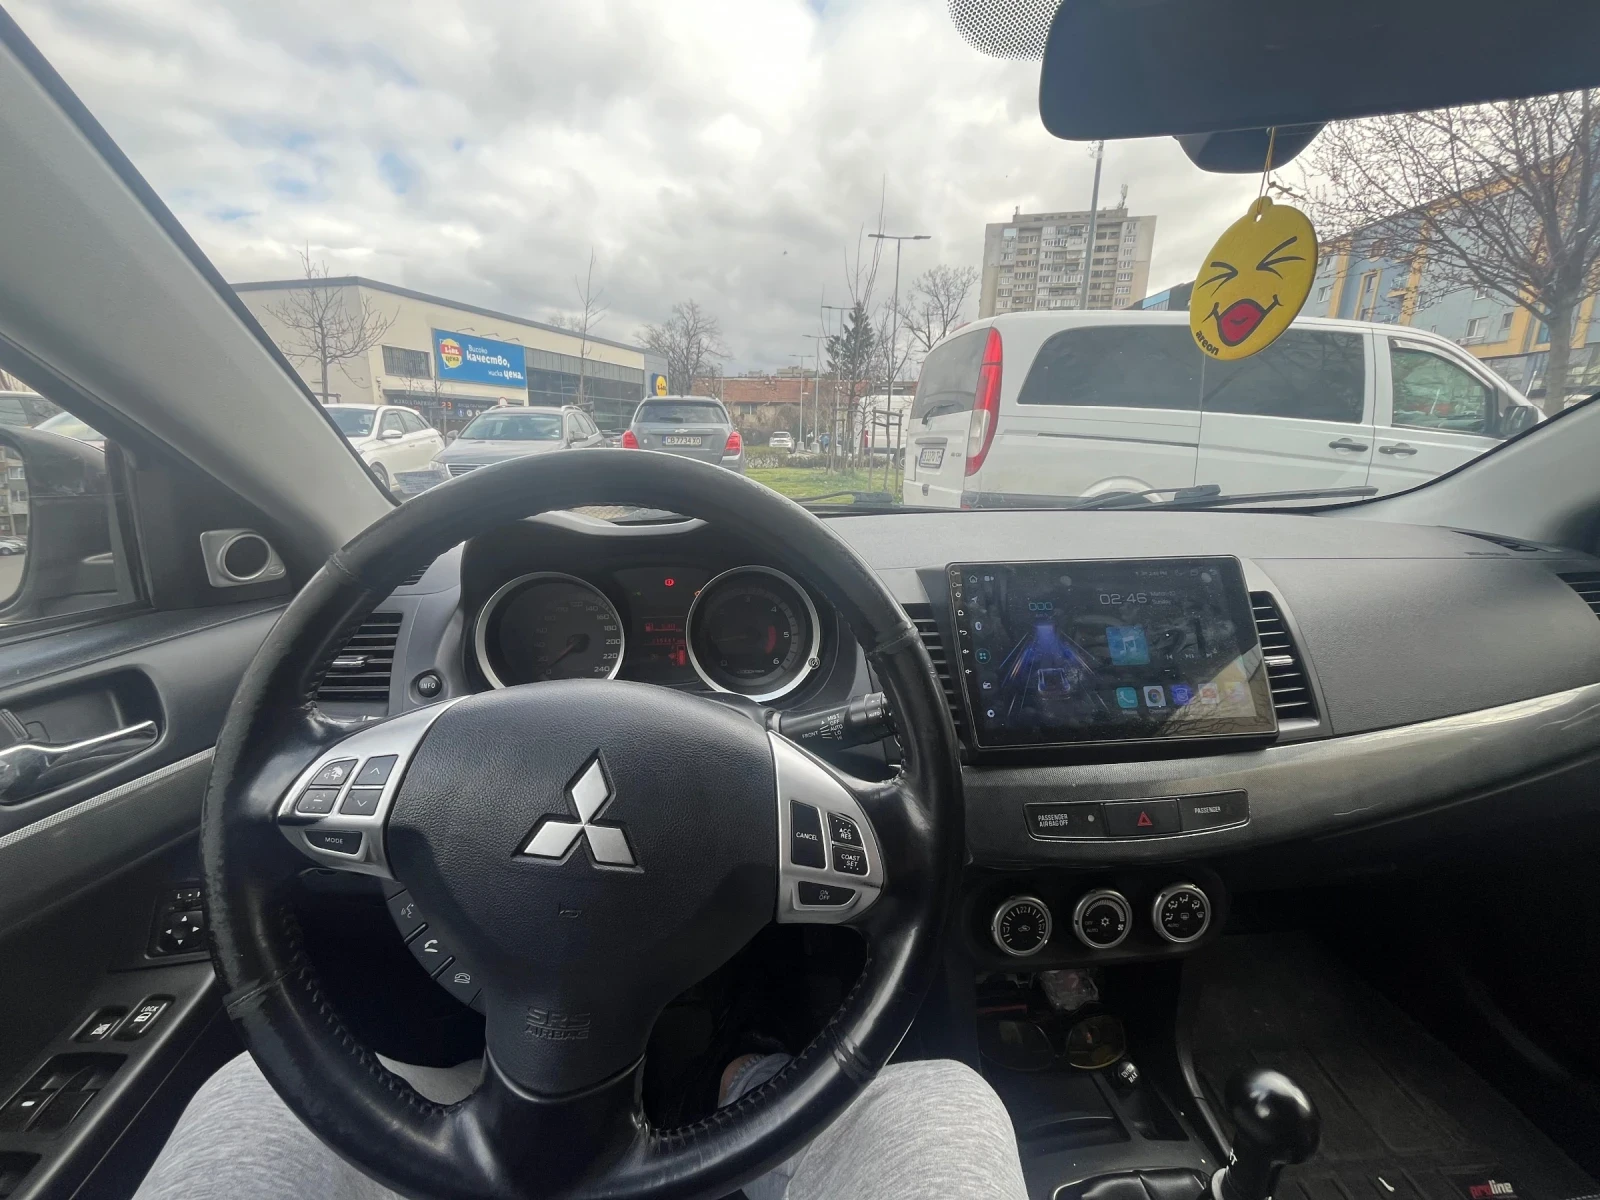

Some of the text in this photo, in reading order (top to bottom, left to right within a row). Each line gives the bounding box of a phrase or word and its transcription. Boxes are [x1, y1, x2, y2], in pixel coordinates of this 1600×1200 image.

[1195, 330, 1219, 356] areon
[466, 350, 510, 368] качество,
[503, 370, 524, 379] цена.
[1099, 593, 1147, 605] 02:46
[827, 713, 840, 721] MIST
[1194, 806, 1221, 814] PASSENGER
[1038, 813, 1068, 821] PASSENGER
[796, 832, 818, 841] CANCEL
[324, 837, 343, 845] MODE
[1020, 905, 1027, 913] 22
